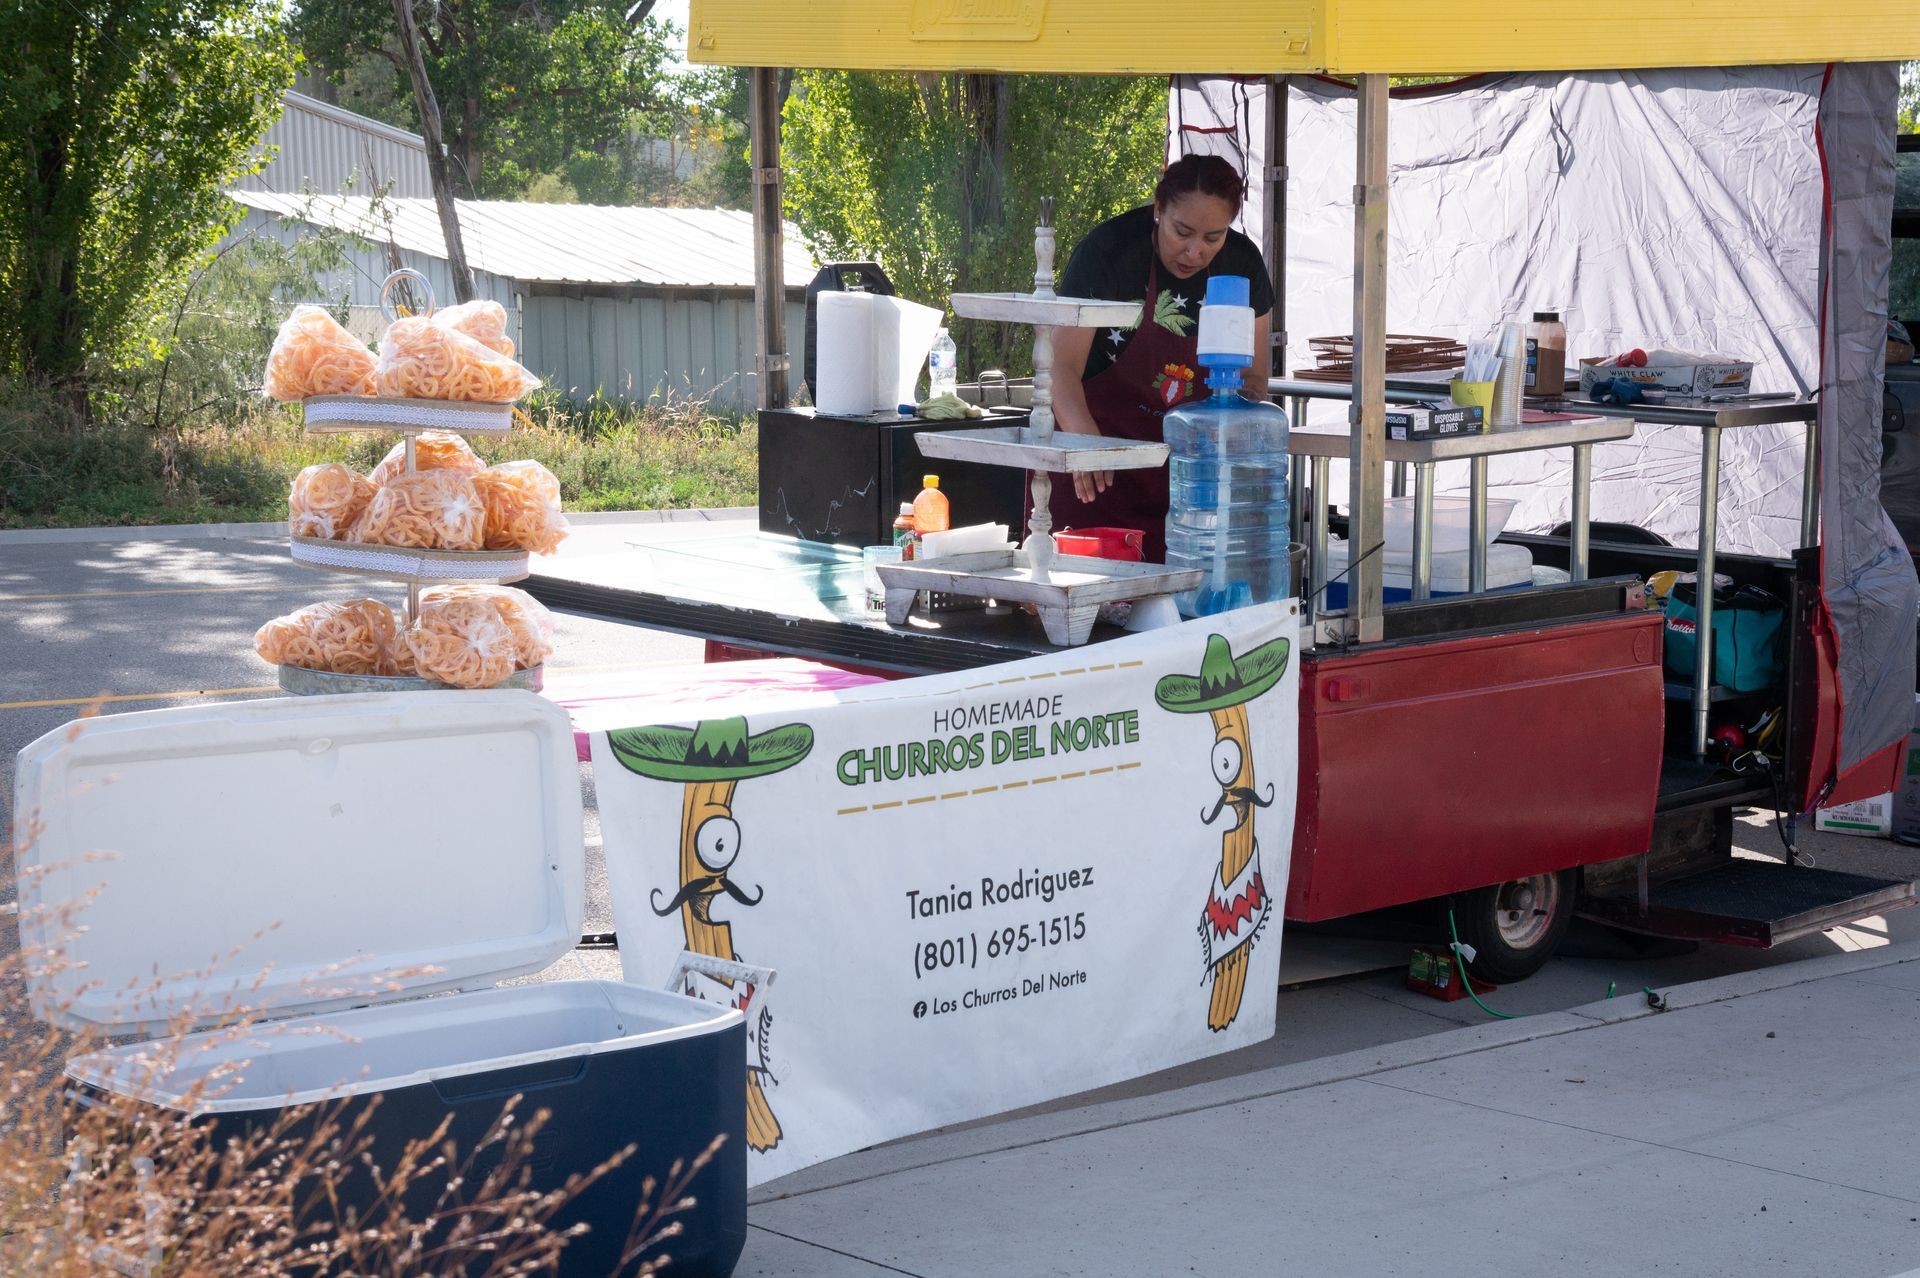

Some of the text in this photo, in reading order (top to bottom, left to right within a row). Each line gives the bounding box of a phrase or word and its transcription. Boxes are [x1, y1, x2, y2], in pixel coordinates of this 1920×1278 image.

[1609, 370, 1637, 378] WHITE
[1434, 412, 1464, 424] DISPOSABLE
[1440, 423, 1459, 433] GLOVES
[872, 599, 887, 611] TIP
[934, 694, 1064, 733] HOMEMADE
[836, 709, 1140, 786] CHURROS DEL NORTE
[906, 867, 1094, 919] Tania Rodriguez
[914, 912, 1087, 979] (801) 695-1515
[933, 997, 957, 1015] Los
[962, 987, 1018, 1009] Churros
[1022, 974, 1044, 996] Del
[1049, 969, 1087, 991] Norte
